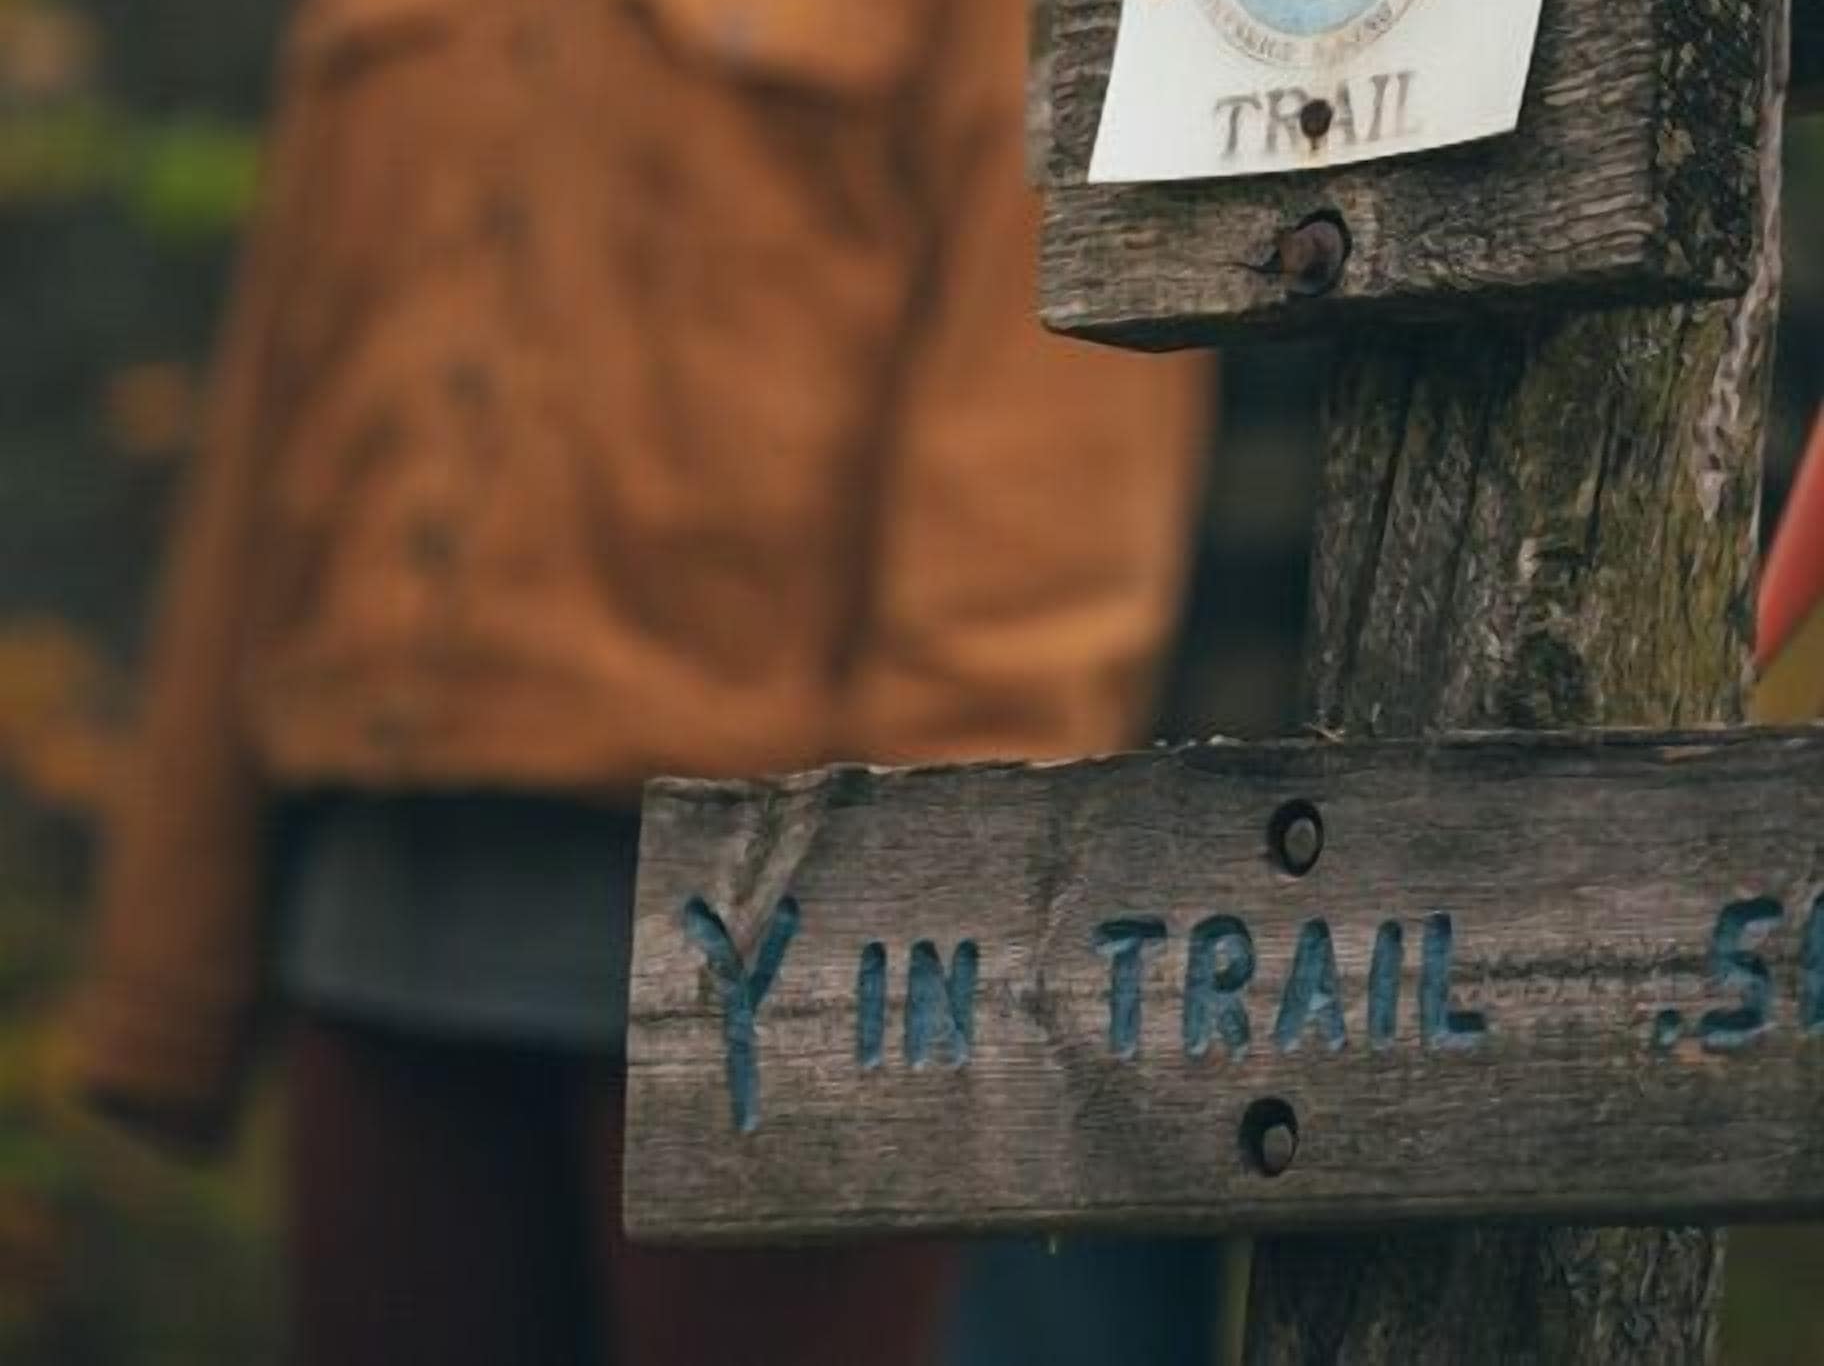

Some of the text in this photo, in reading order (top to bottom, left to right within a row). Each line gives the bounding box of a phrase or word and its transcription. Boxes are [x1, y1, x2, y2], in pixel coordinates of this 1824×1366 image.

[1214, 69, 1424, 158] TRAIL
[855, 939, 980, 1071] IN
[1093, 910, 1486, 1064] TRAIL
